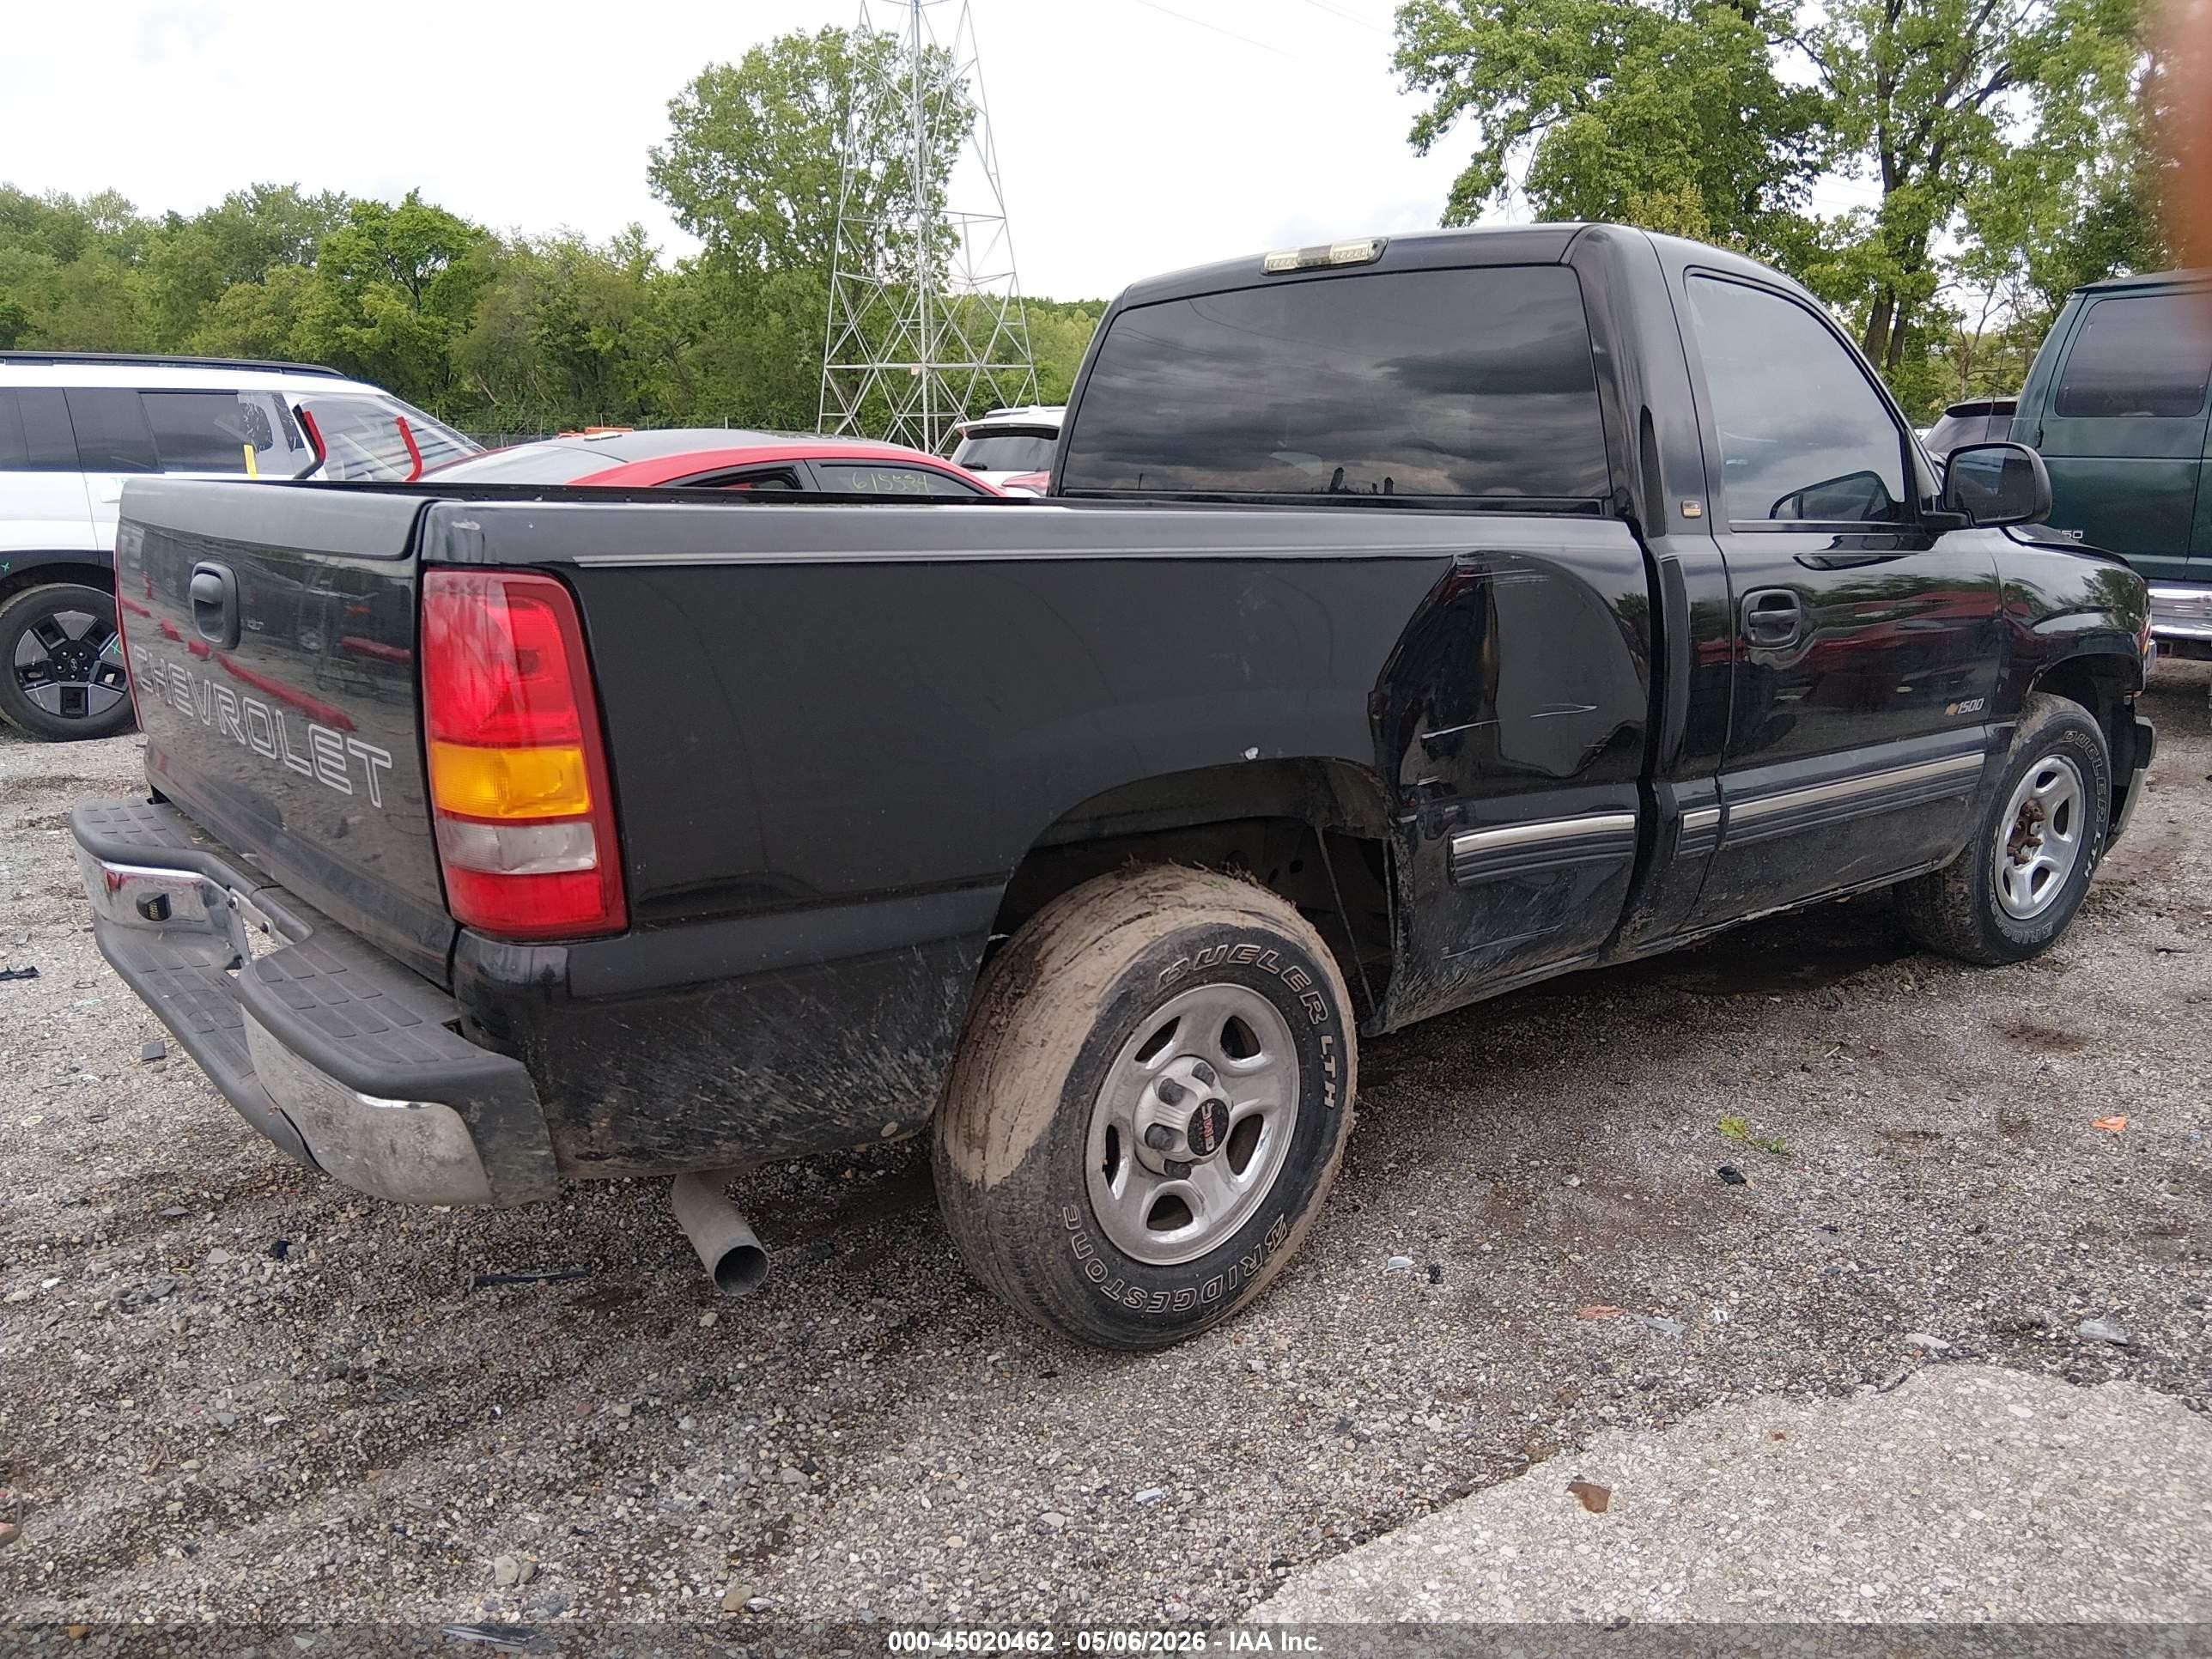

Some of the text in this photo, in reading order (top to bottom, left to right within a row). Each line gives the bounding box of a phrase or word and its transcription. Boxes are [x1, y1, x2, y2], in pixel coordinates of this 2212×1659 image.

[134, 645, 392, 808] CHEVROLET
[1958, 697, 1984, 714] 1500
[2062, 730, 2108, 823] DUELER
[1156, 944, 1337, 1109] DUELER LTH
[1202, 1103, 1215, 1152] GMC
[1062, 1206, 1289, 1314] BRIDGESTONE
